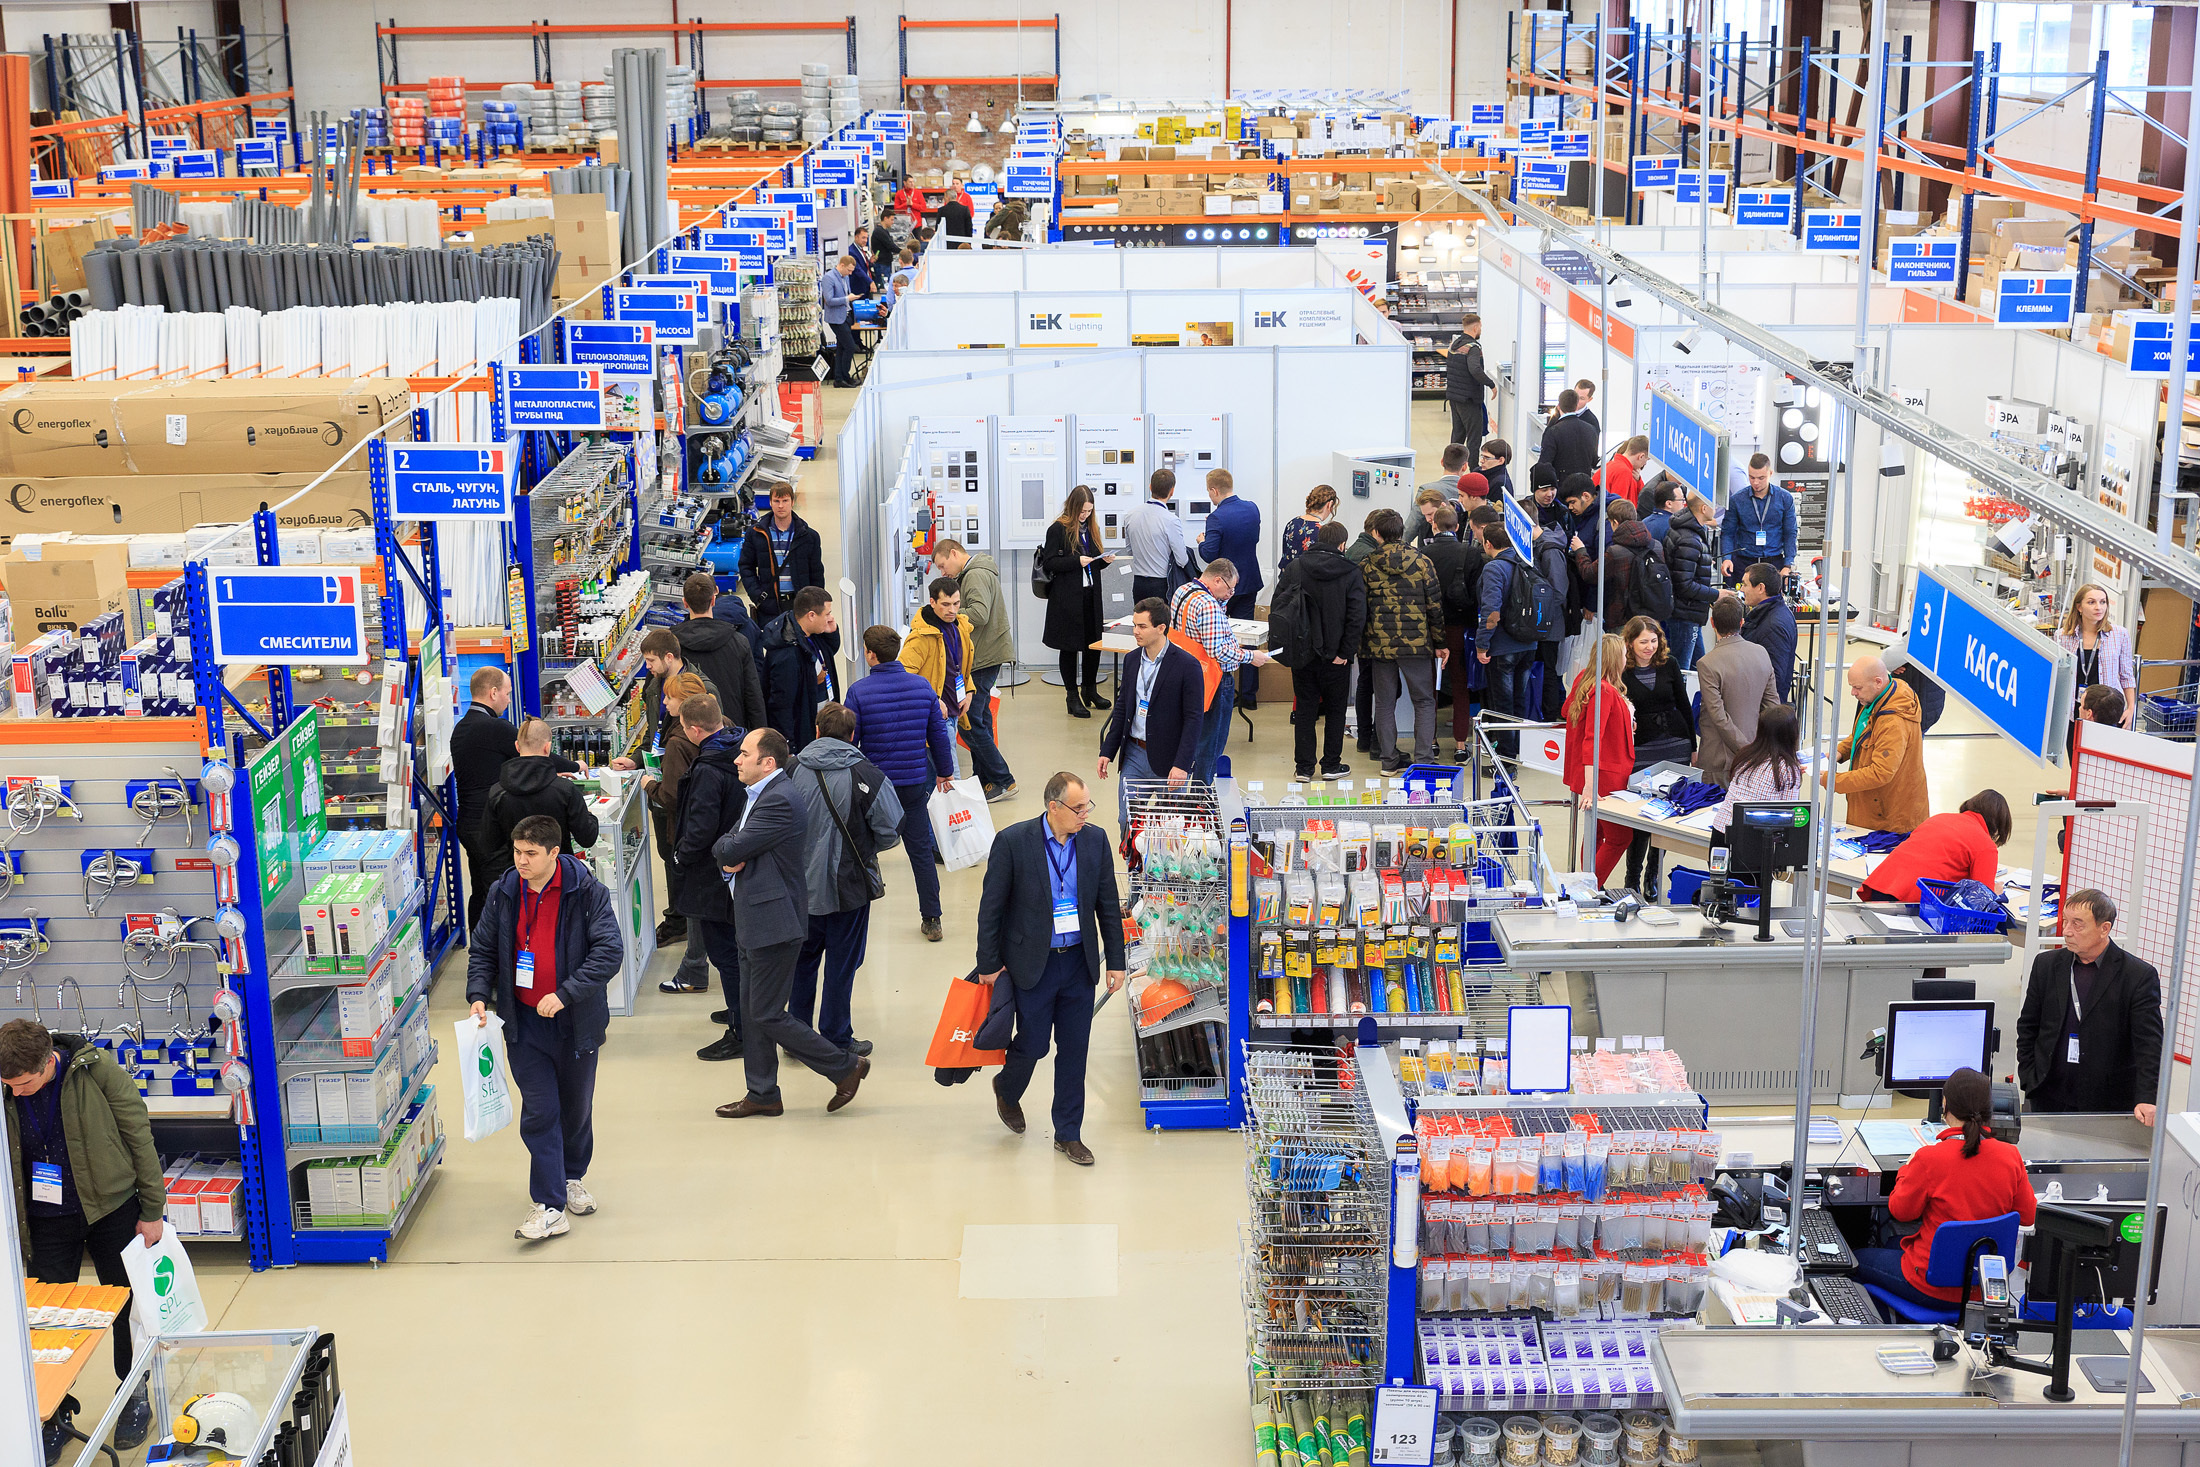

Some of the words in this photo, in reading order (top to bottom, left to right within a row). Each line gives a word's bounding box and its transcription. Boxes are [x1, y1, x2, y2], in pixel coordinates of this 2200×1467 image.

[1008, 167, 1018, 175] 13
[1556, 164, 1565, 173] 13
[56, 185, 67, 194] 11
[801, 193, 812, 202] 11
[1743, 211, 1784, 219] УДЛИНИТЕЛИ
[732, 218, 739, 227] 9
[707, 234, 714, 244] 8
[1813, 234, 1858, 243] УДЛИНИТЕЛИ
[675, 258, 682, 268] 7
[1894, 261, 1951, 270] НАКОНЕЧНИКИ,
[1907, 269, 1937, 277] ГИЛЬЗЫ
[622, 296, 630, 308] 5
[2016, 304, 2053, 313] КЛЕММЫ
[656, 327, 691, 335] НАСОСЫ
[1069, 322, 1103, 332] Lighting
[573, 327, 583, 340] 4
[576, 353, 649, 362] ТЕПЛОИЗОЛЯЦИЯ,
[2153, 351, 2195, 361] ХОМЫ
[512, 372, 522, 387] 3
[514, 400, 596, 410] МЕТАЛЛОПЛАСТИК,
[1904, 397, 1924, 406] ЭРА
[515, 411, 543, 420] ТРУБЫ
[544, 411, 564, 421] ПНД
[1999, 412, 2019, 425] ЭРА
[37, 419, 91, 431] energoflex
[264, 426, 319, 436] energoflex
[1655, 416, 1660, 440] 1
[1667, 424, 1696, 467] КАССЫ
[1703, 455, 1710, 479] 2
[398, 452, 410, 469] 2
[412, 481, 454, 494] СТАЛЬ,
[456, 481, 500, 495] ЧУГУН,
[40, 495, 104, 509] energoflex
[452, 498, 500, 509] ЛАТУНЬ
[279, 515, 343, 527] energoflex
[222, 579, 234, 600] 1
[35, 604, 68, 618] Ballu
[259, 636, 352, 649] СМЕСИТЕЛИ
[1920, 601, 1931, 637] 3
[1964, 633, 2018, 708] КАССА
[292, 720, 316, 752] ГЕЙЗЕР
[254, 754, 280, 789] ГЕЙЗЕР
[949, 809, 972, 827] ABB
[159, 1292, 182, 1320] SPL
[1390, 1434, 1417, 1445] 123
